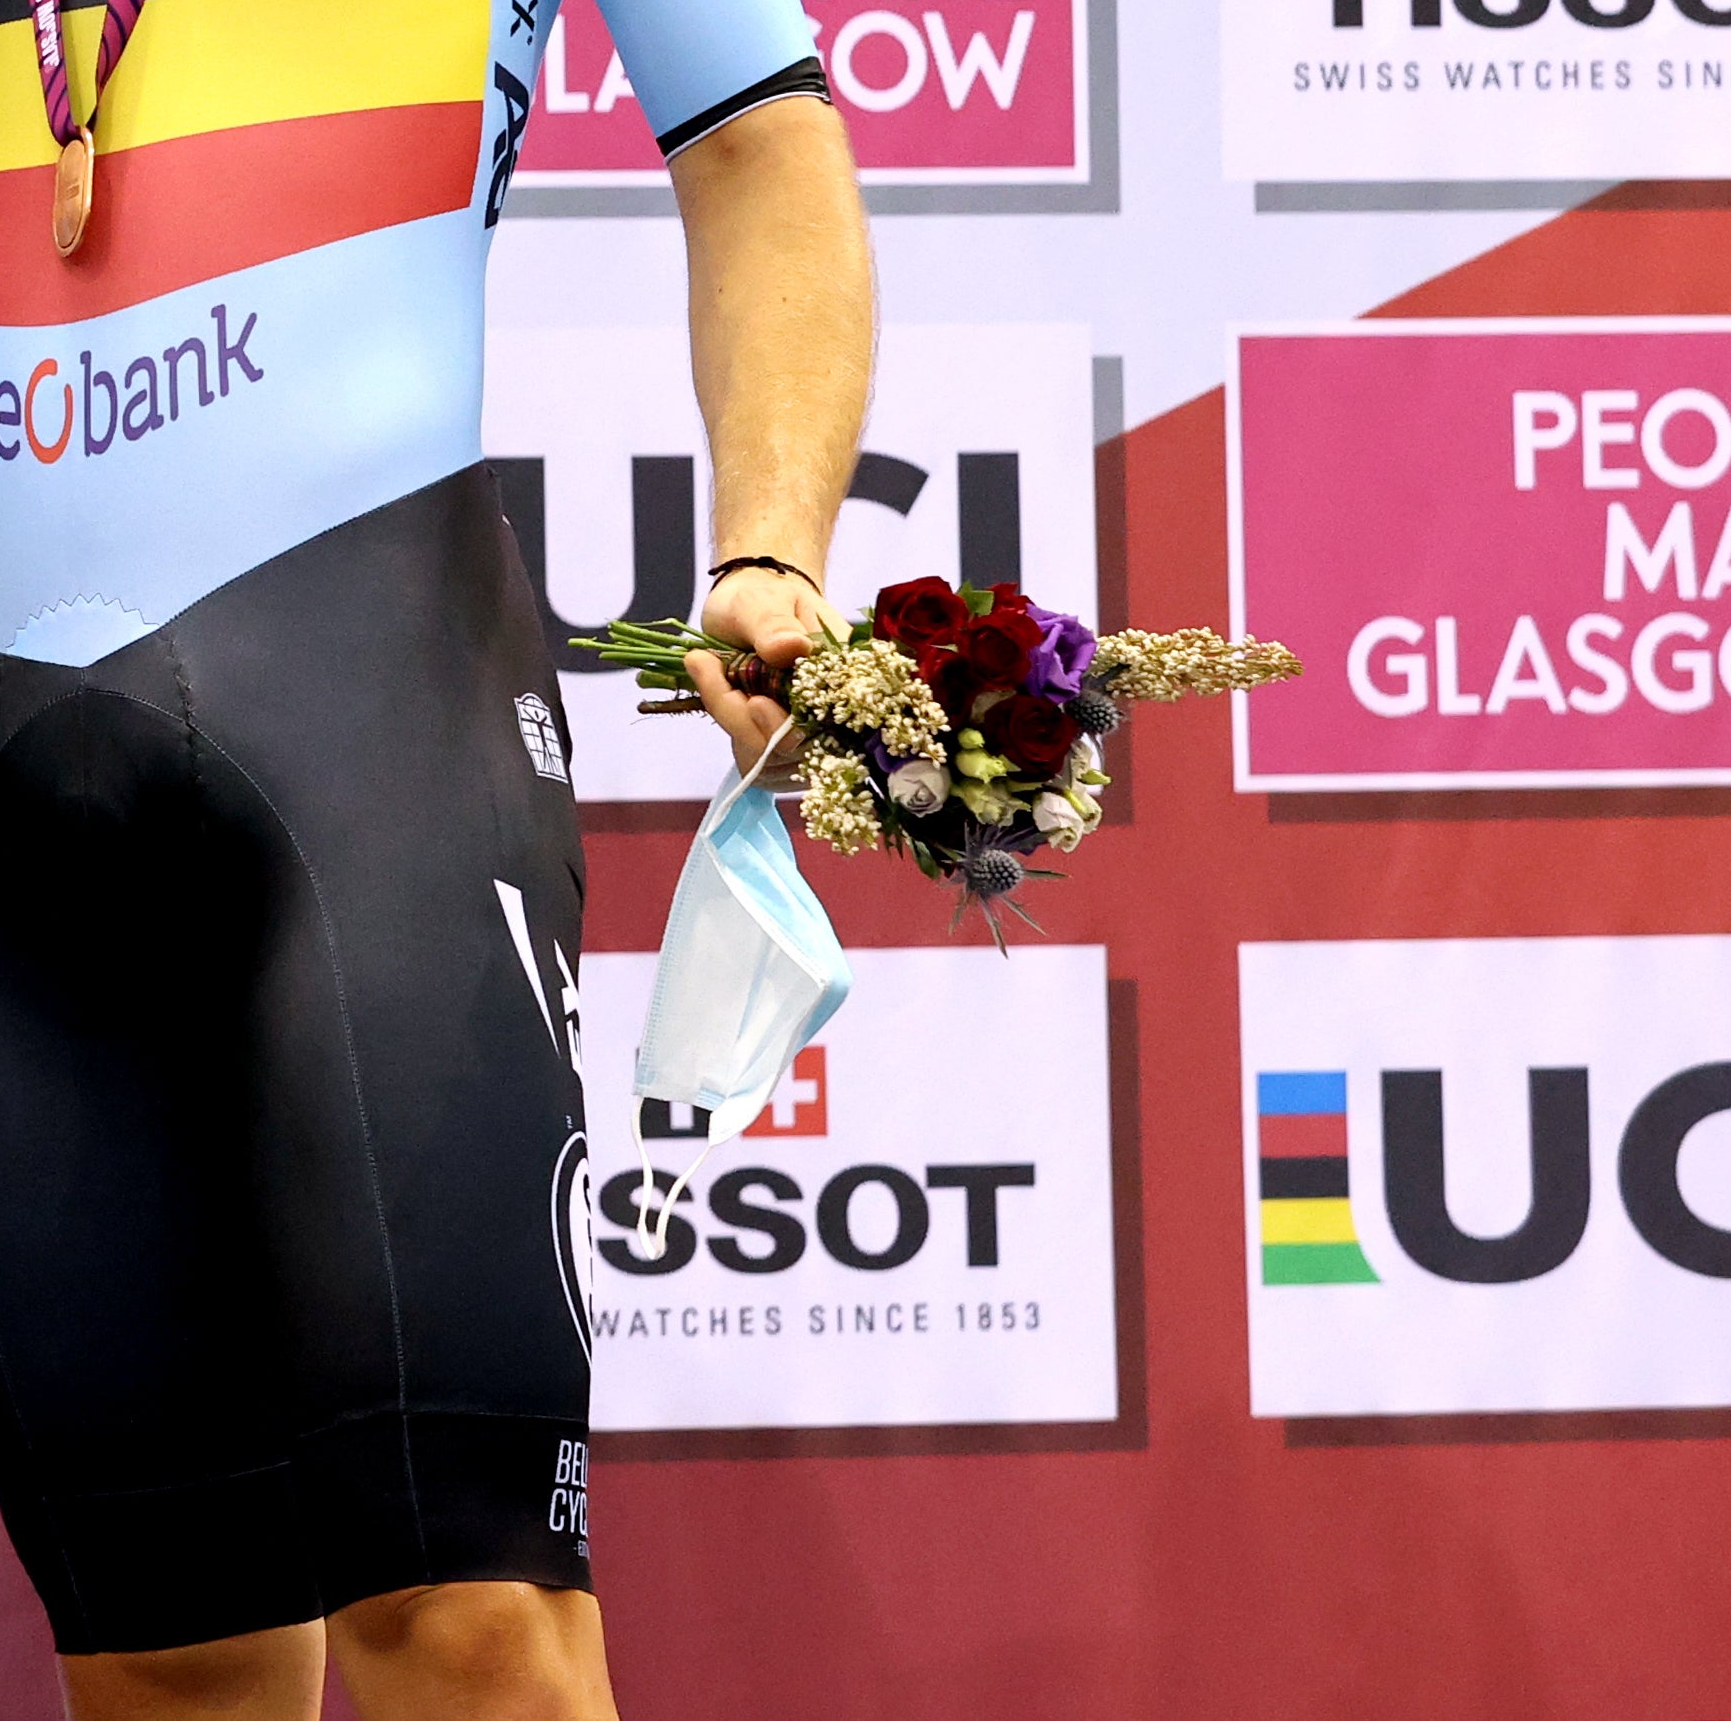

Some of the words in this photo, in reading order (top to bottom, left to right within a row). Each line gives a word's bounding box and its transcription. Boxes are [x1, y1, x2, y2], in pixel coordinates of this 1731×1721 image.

[1293, 60, 1421, 92] SWISS
[1443, 60, 1633, 92] WATCHES
[1346, 612, 1731, 719] GLASG
[596, 1161, 1036, 1278] SSOT
[808, 1304, 931, 1335] SINCE
[954, 1301, 1042, 1333] 1853
